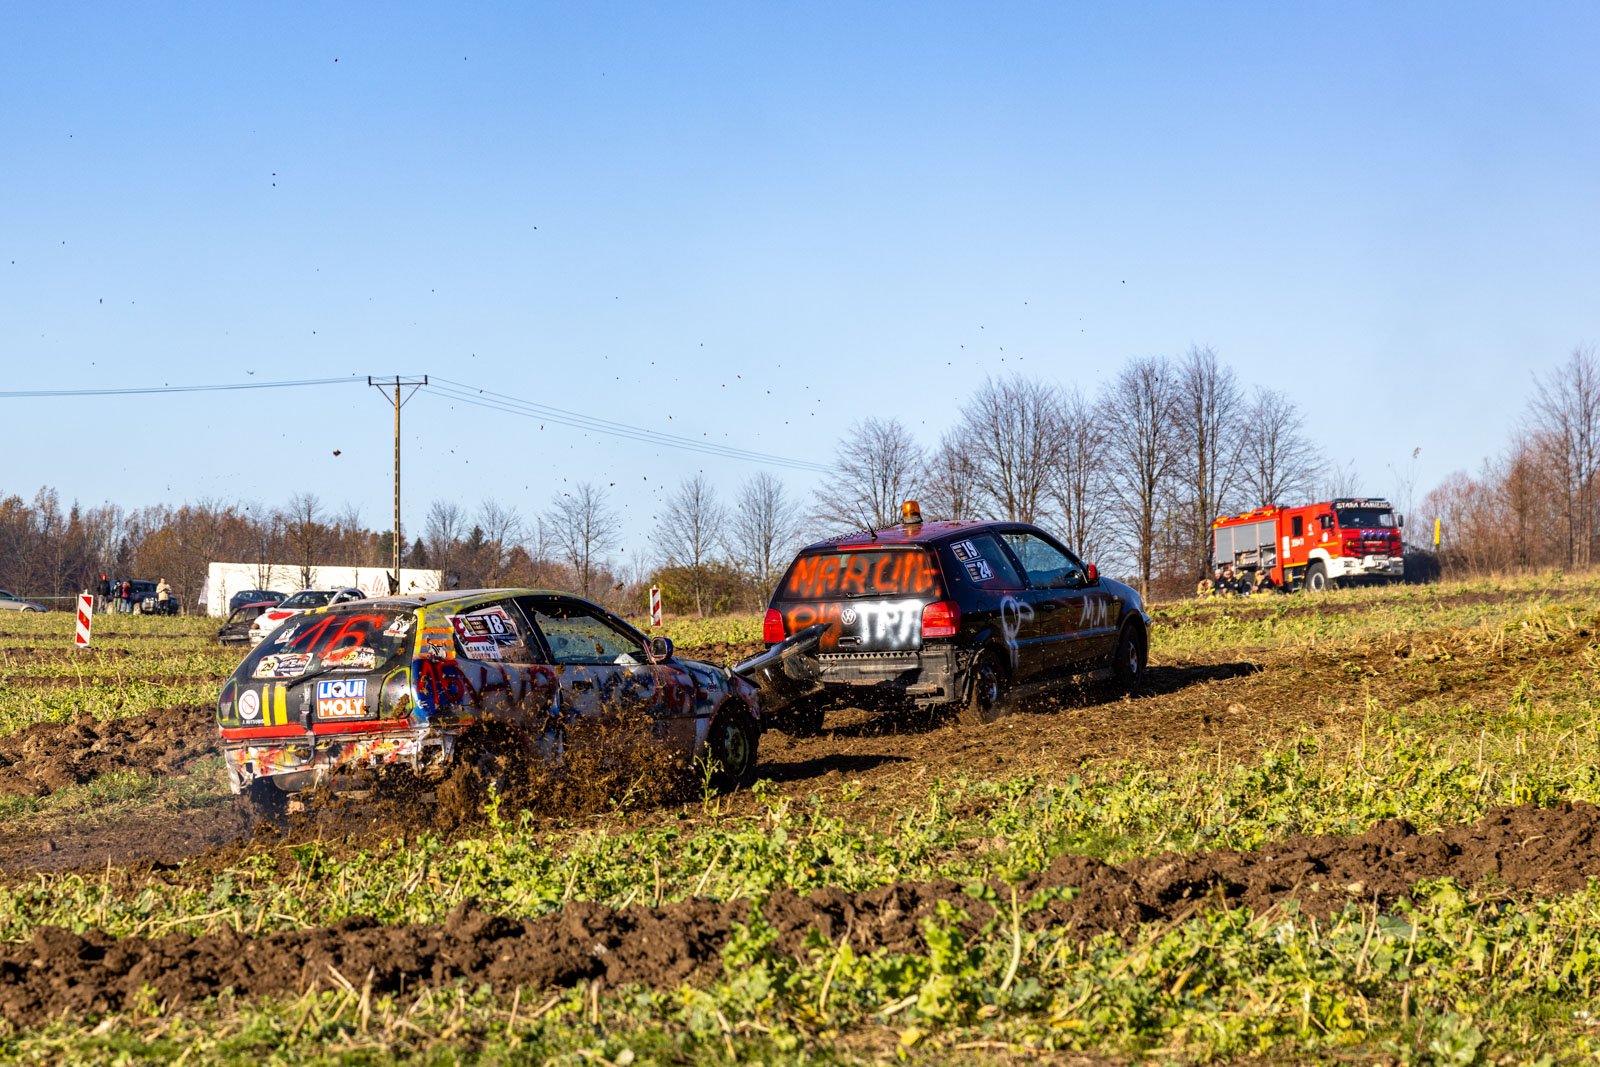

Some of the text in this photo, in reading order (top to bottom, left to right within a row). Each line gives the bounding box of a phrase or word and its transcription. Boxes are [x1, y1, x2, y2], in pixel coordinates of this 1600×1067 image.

[962, 541, 978, 558] 19
[977, 560, 993, 579] 24
[483, 615, 505, 634] 18
[261, 662, 275, 672] 29
[319, 680, 365, 699] LIQUI
[319, 699, 364, 717] MOLY
